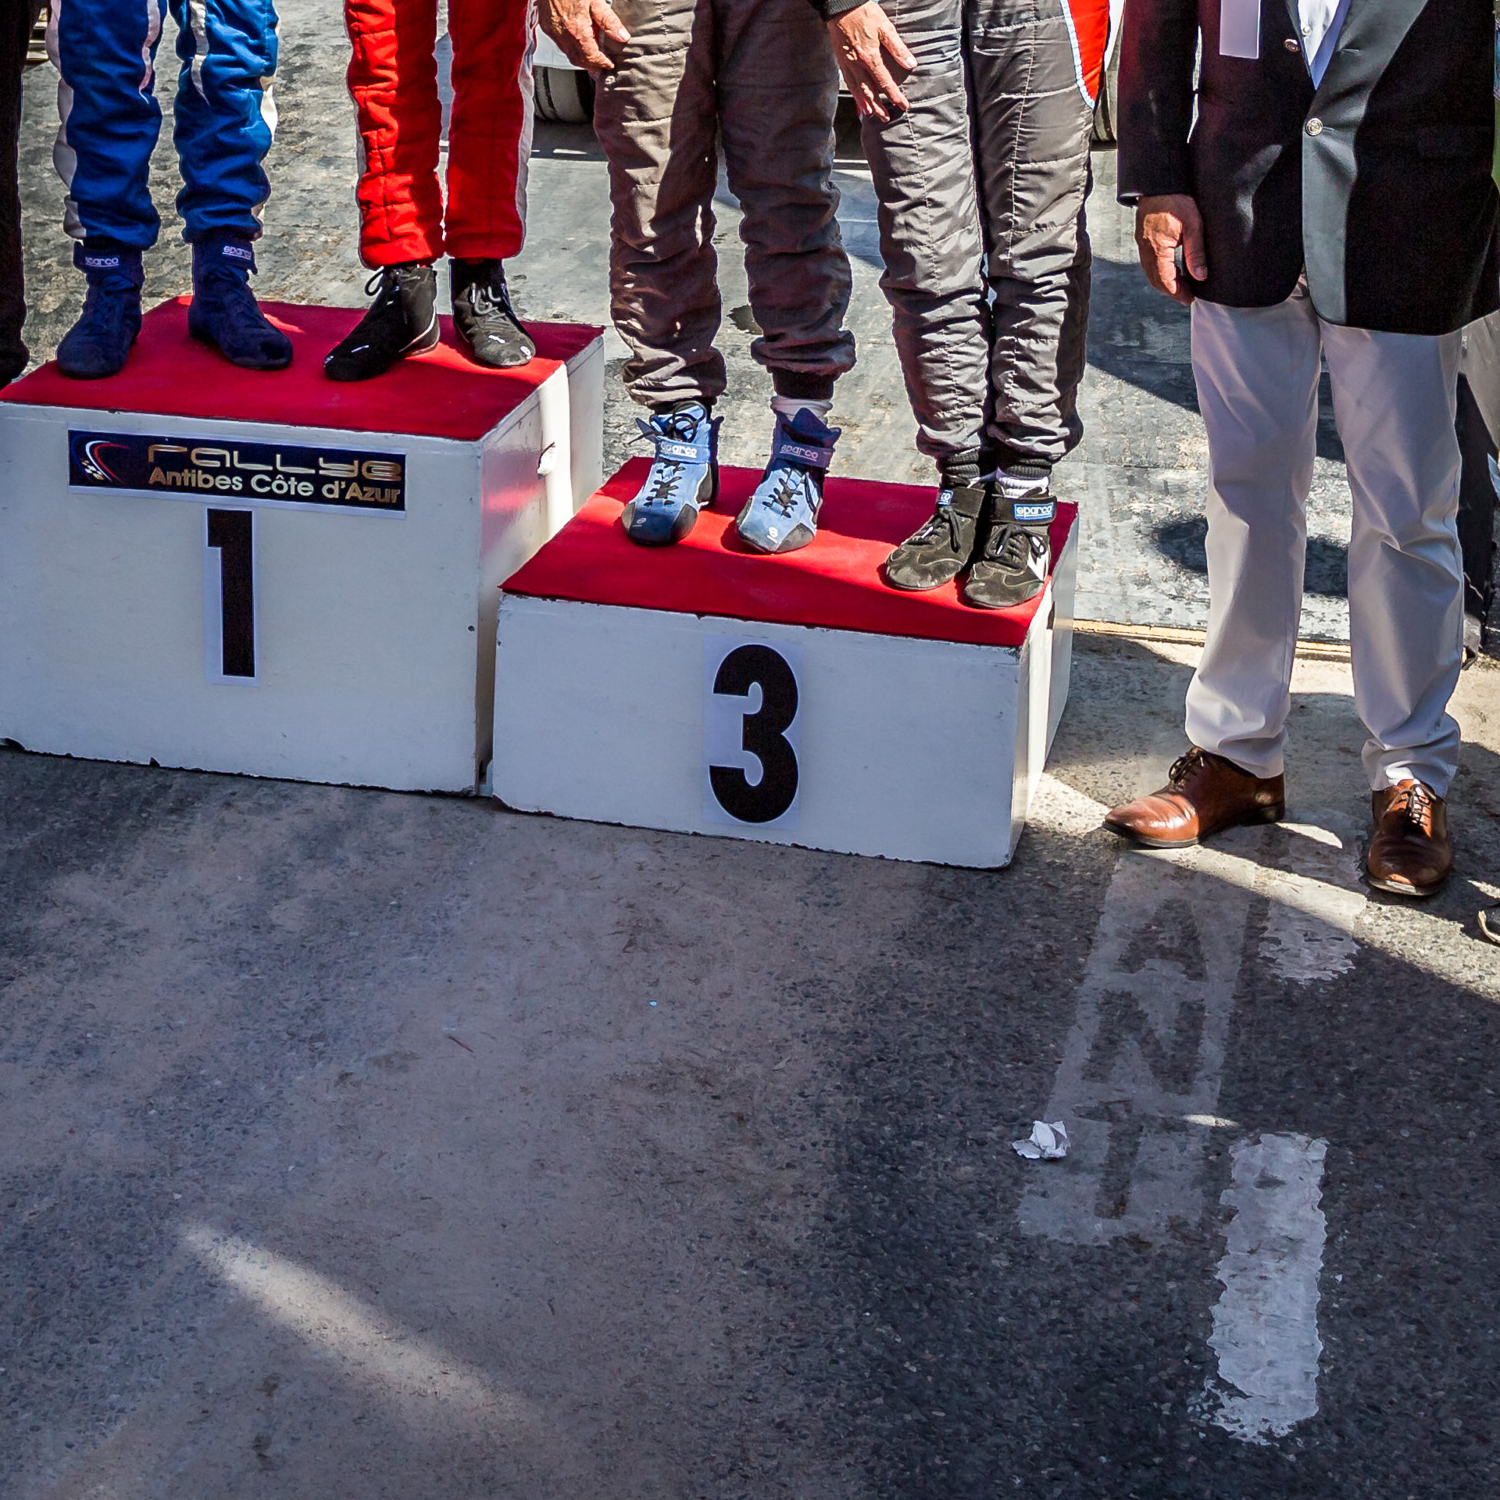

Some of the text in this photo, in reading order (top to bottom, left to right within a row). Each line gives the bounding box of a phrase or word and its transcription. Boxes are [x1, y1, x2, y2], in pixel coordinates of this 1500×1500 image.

[780, 444, 819, 460] sparco
[148, 466, 402, 505] Antibes Côte d'Azur
[1017, 505, 1053, 518] sparco
[207, 508, 256, 678] 1
[709, 643, 800, 824] 3
